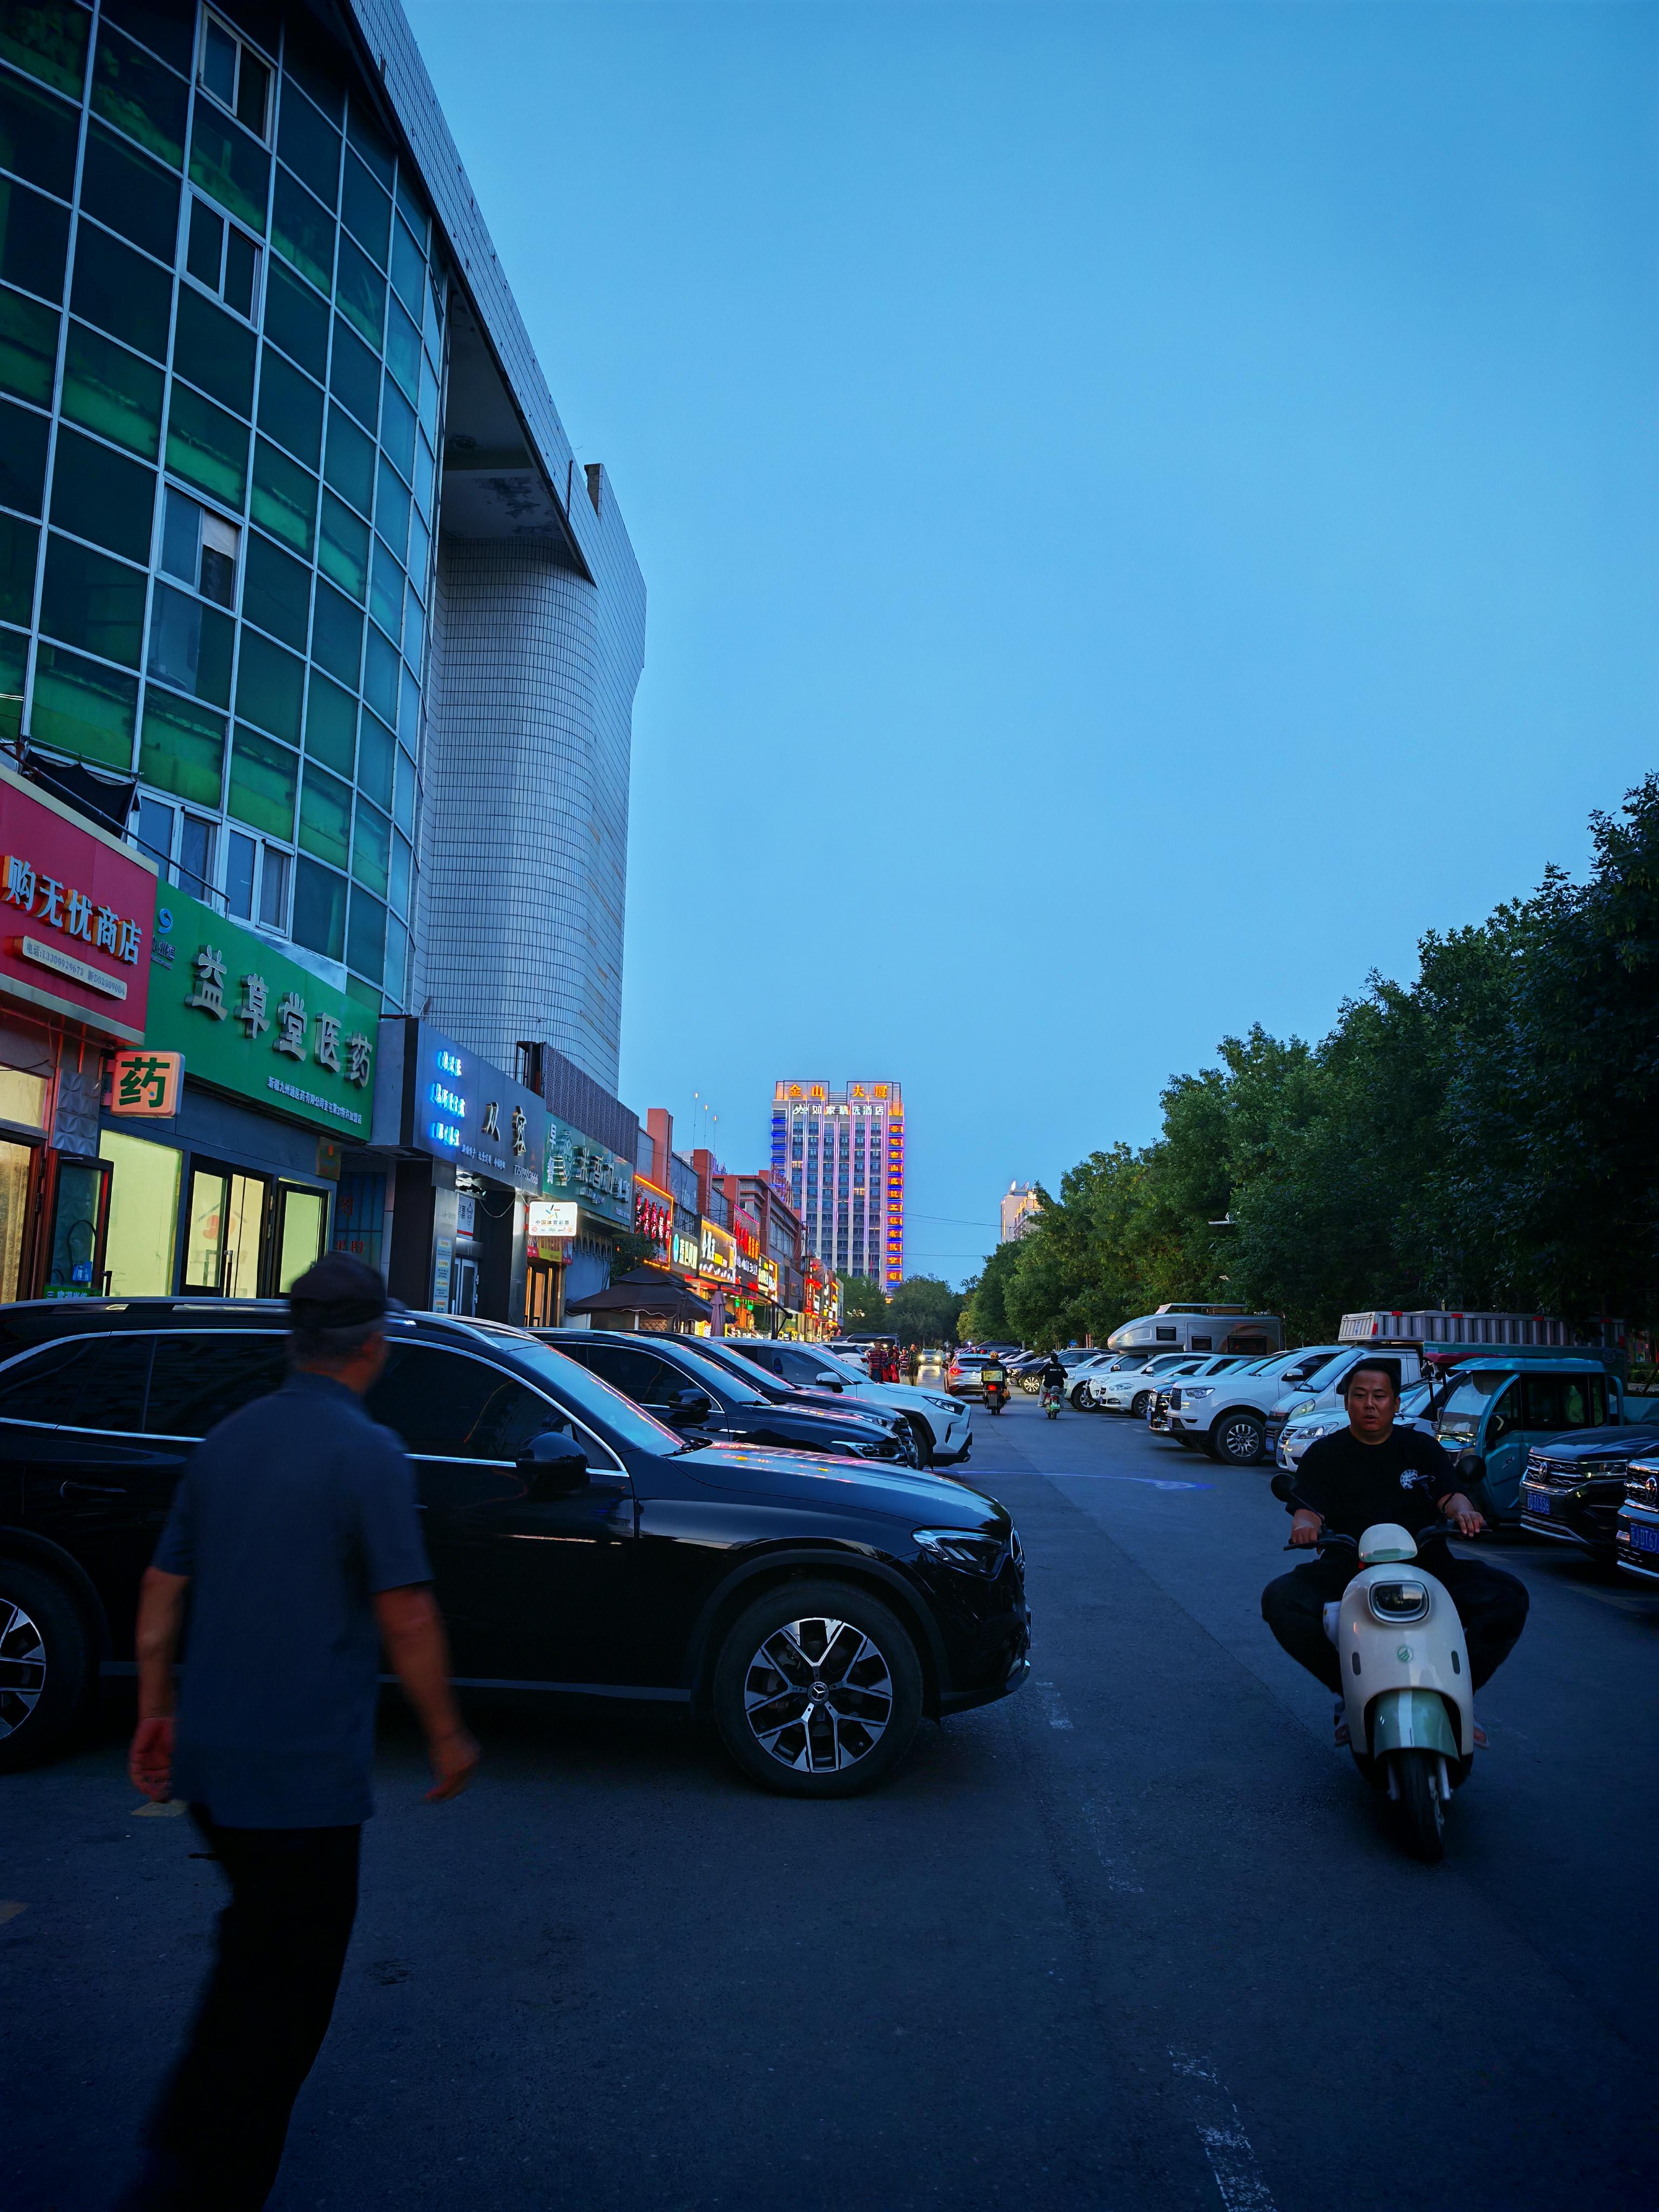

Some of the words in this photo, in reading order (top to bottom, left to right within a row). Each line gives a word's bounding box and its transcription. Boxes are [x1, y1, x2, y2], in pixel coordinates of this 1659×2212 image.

[6, 855, 143, 965] 购无忧商店
[189, 945, 373, 1089] 益草堂医药
[119, 1057, 170, 1108] 药
[790, 1084, 887, 1098] 金山大厦
